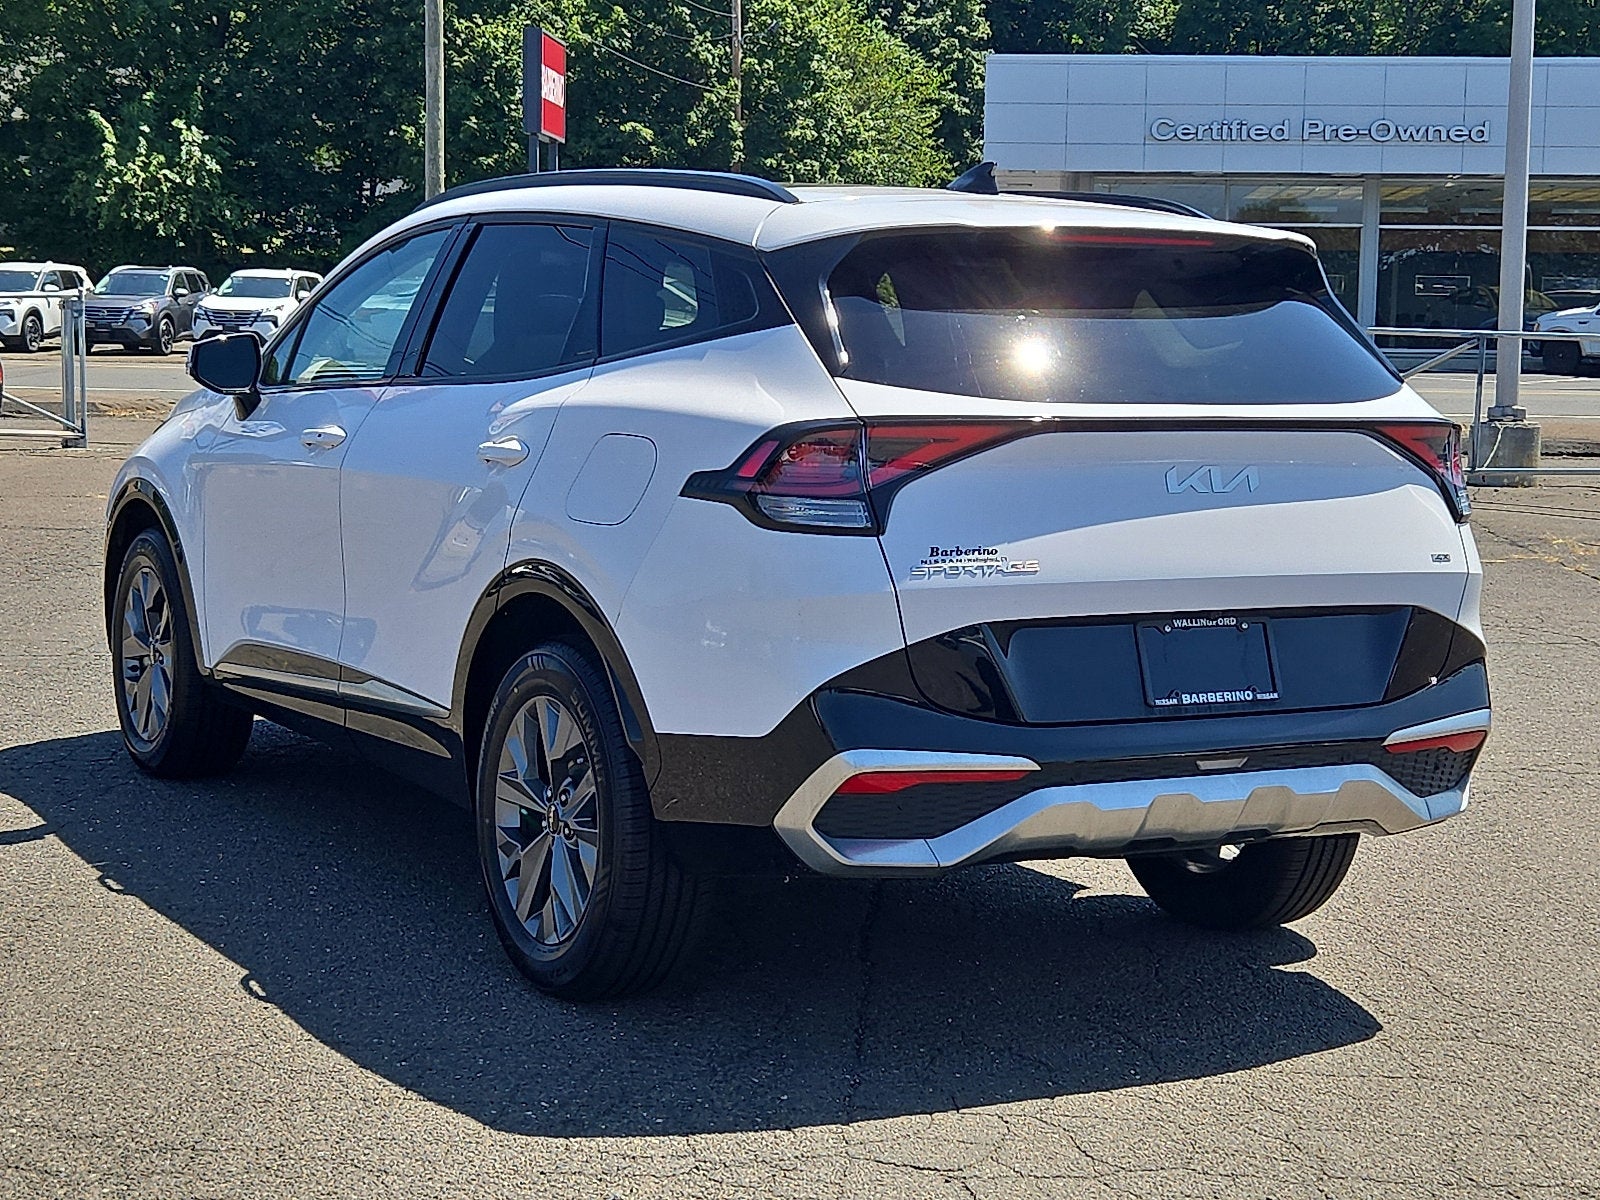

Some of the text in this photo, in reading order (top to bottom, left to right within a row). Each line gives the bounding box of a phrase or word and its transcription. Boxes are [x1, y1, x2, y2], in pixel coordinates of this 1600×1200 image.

[1150, 118, 1491, 142] Certified Pre-Owned
[1164, 464, 1260, 494] KIA
[929, 545, 998, 557] Barberino
[1181, 690, 1254, 704] BARBERINO
